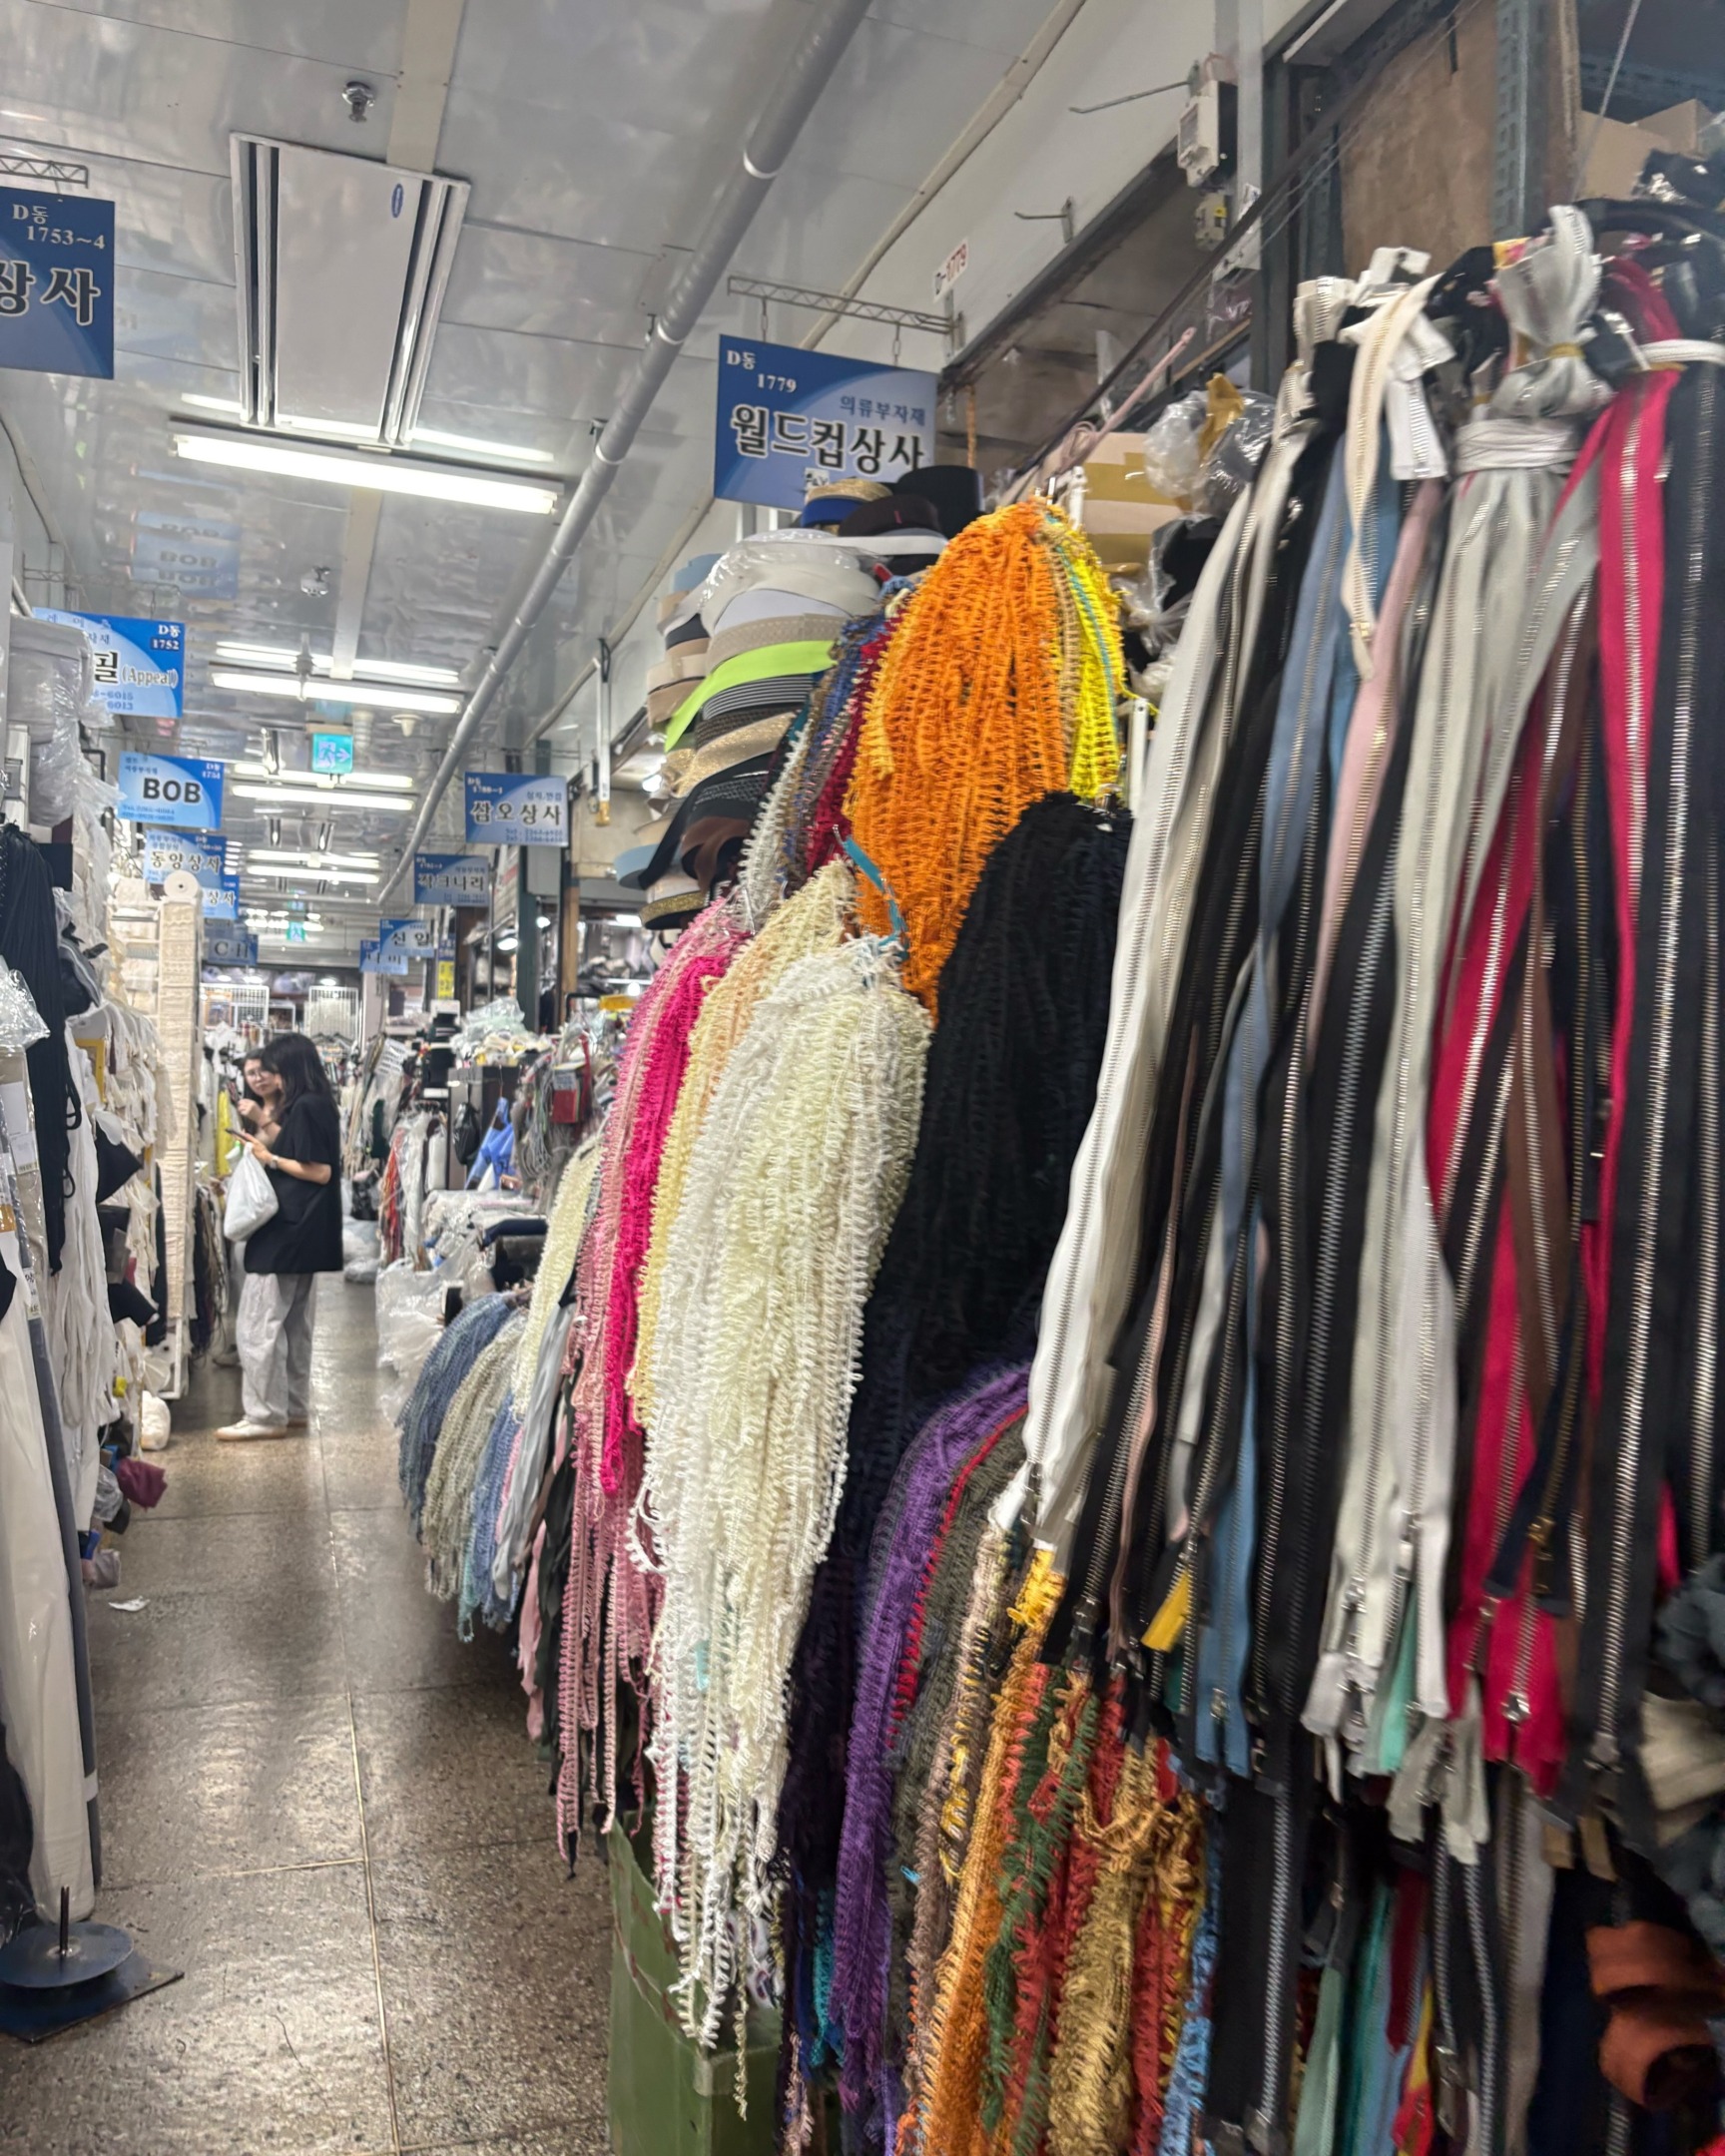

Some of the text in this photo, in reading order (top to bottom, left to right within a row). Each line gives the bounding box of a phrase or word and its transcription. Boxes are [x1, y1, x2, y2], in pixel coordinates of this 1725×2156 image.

[12, 204, 49, 225] D동
[726, 349, 756, 370] D동
[757, 373, 797, 392] 1779
[840, 395, 926, 427] 의류부자재
[731, 403, 925, 476] 월드컵상사
[159, 625, 181, 638] D동
[152, 639, 180, 650] 1752
[143, 778, 202, 803] BOB
[151, 850, 221, 874] 동양상사
